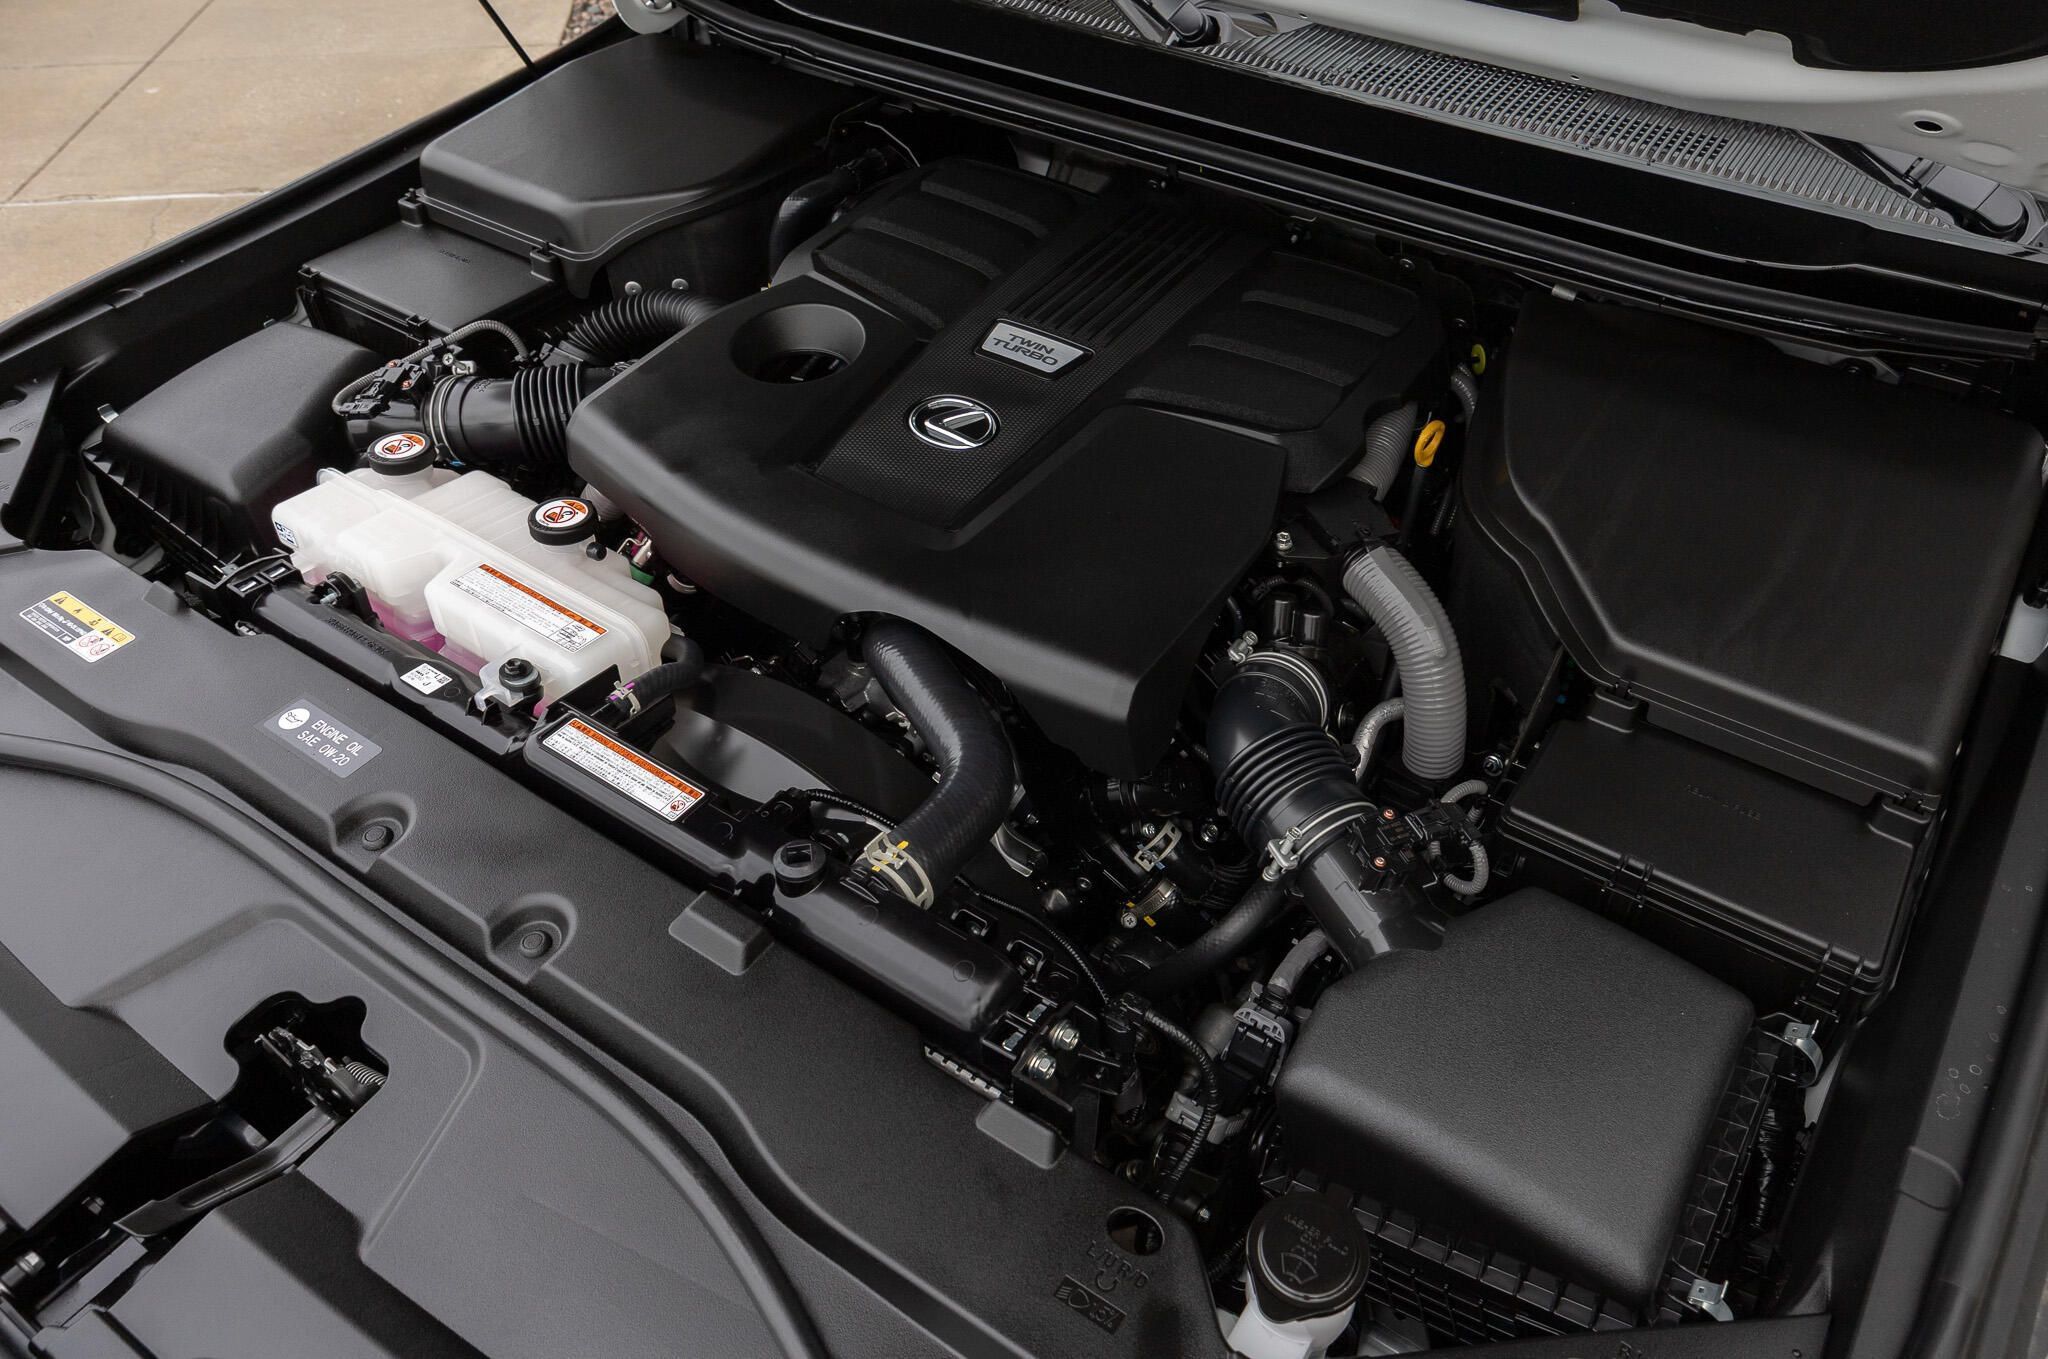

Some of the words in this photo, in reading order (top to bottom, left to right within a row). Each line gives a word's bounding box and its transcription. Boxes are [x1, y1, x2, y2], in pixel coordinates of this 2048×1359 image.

[993, 337, 1058, 366] TURBO
[1009, 333, 1055, 354] TWIN
[297, 730, 321, 747] SAE
[318, 744, 351, 767] 0W-20
[311, 719, 349, 745] ENGINE
[345, 741, 364, 756] OIL
